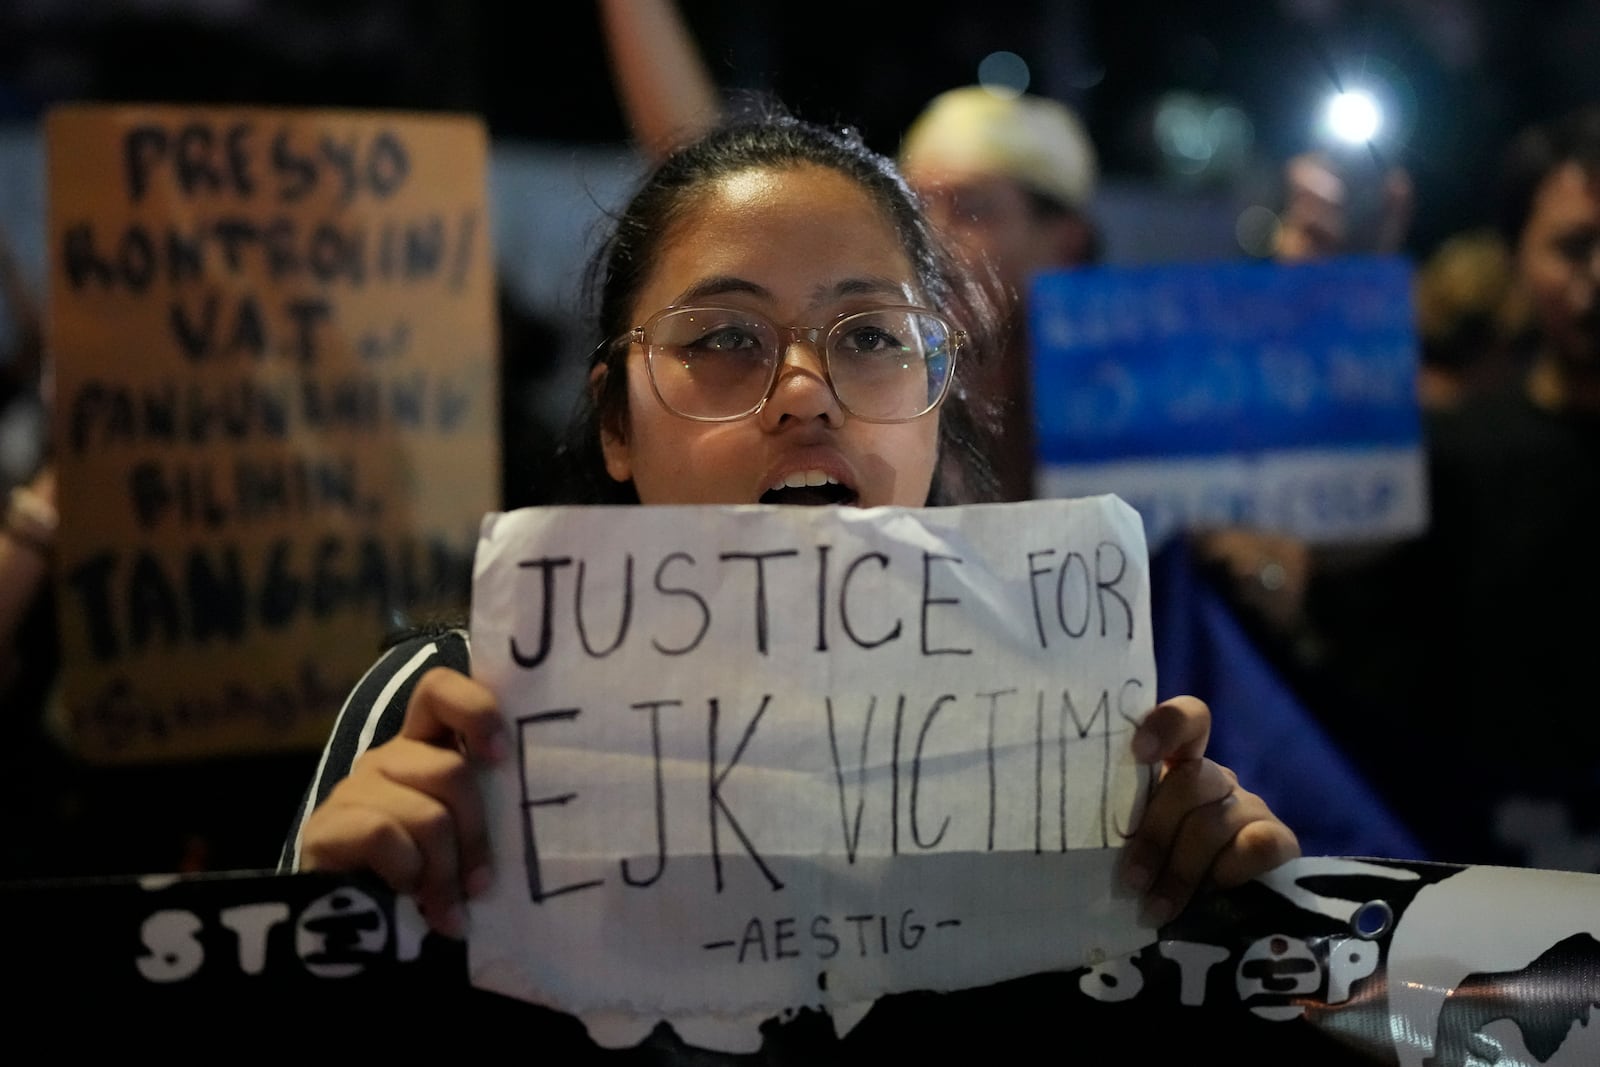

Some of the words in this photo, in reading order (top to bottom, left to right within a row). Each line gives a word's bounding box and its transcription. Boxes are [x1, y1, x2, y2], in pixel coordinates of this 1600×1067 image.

[124, 121, 411, 205] PRESYO
[510, 544, 974, 669] JUSTICE
[1026, 540, 1136, 649] FOR
[514, 693, 786, 904] EJK
[825, 677, 1158, 866] VICTIMS
